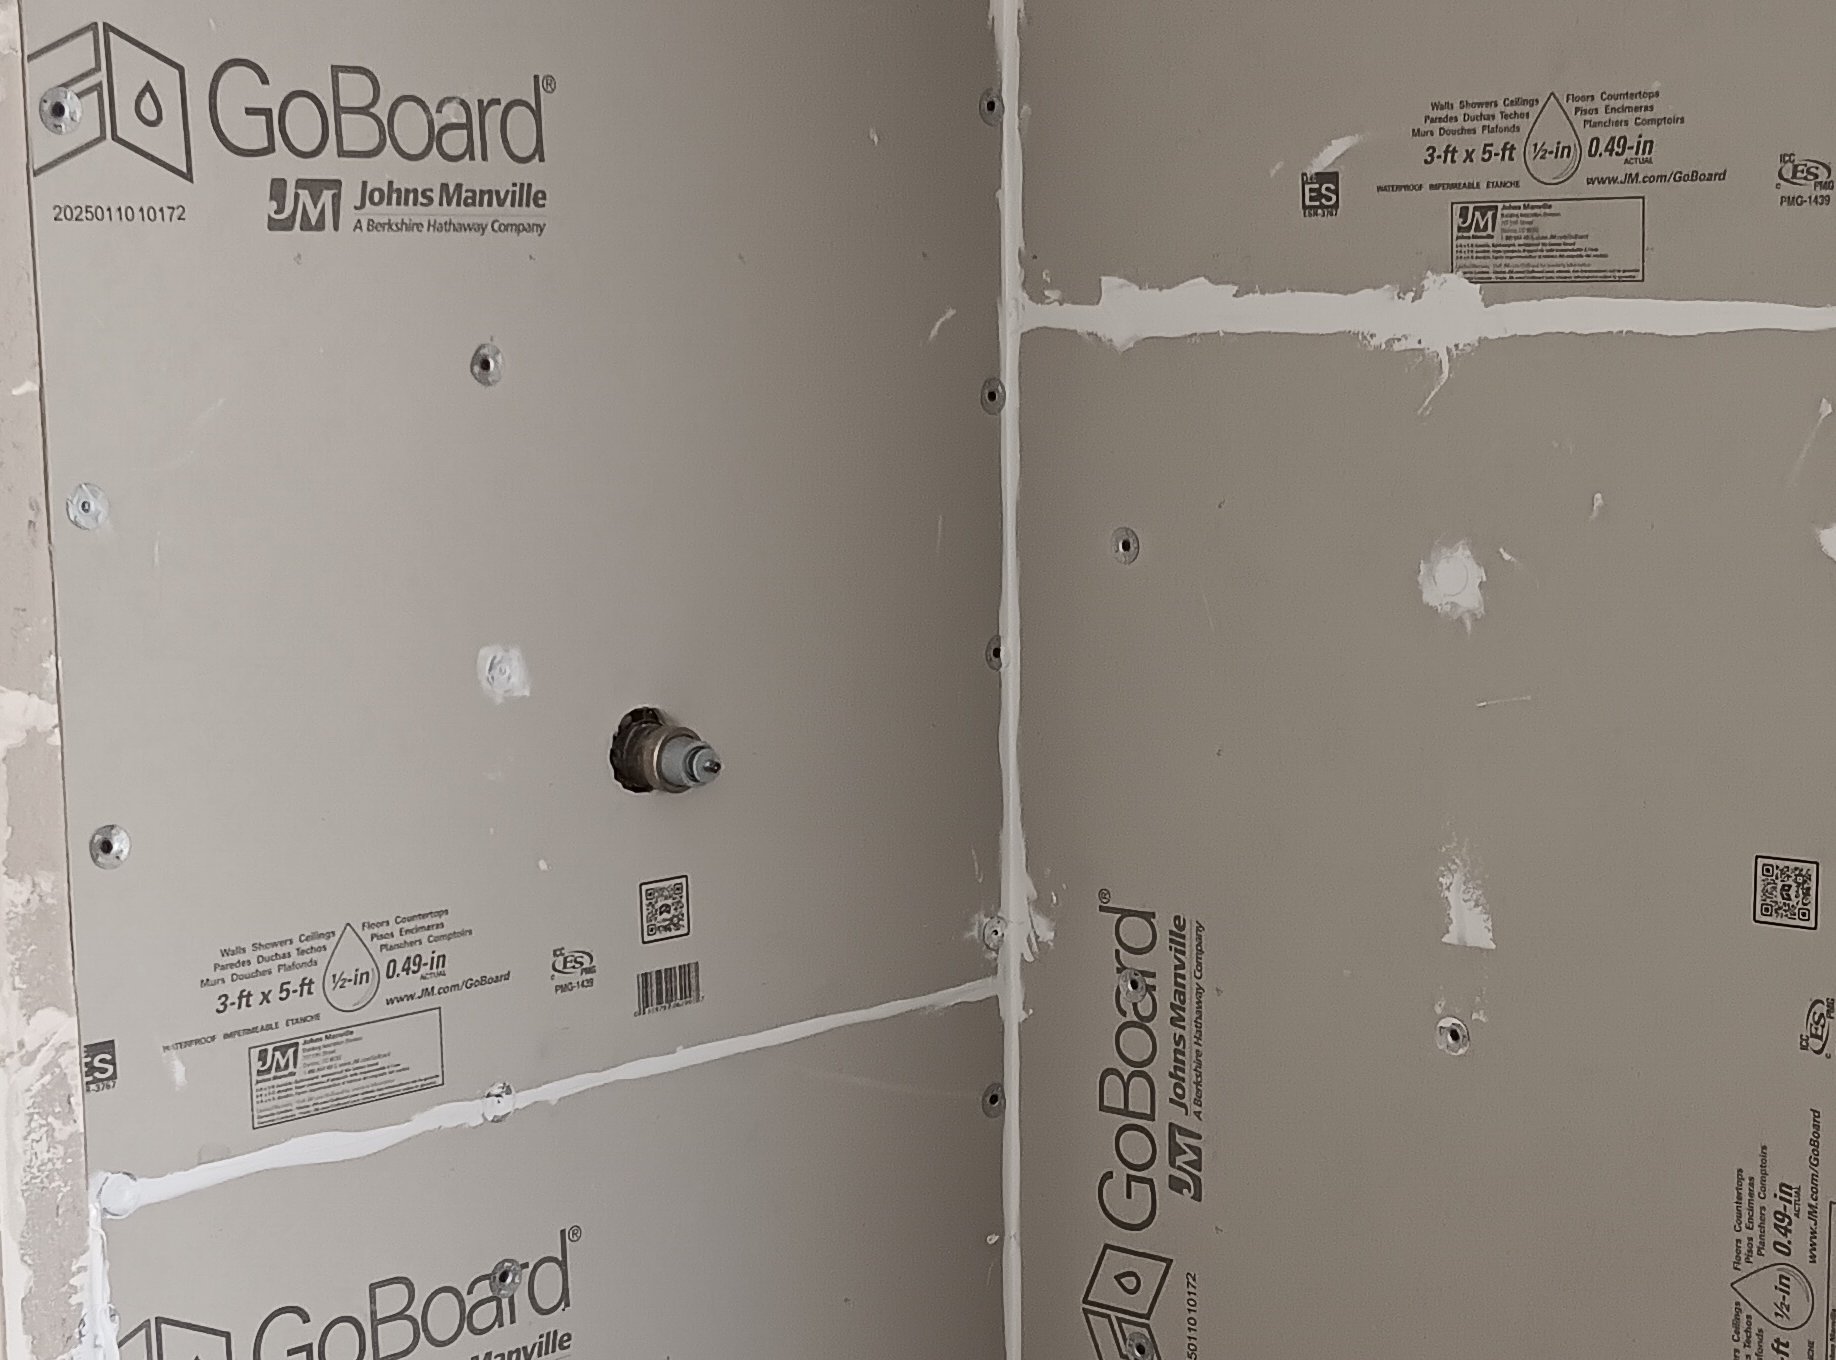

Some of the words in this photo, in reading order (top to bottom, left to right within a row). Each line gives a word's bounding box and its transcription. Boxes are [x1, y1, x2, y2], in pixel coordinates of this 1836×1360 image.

[1566, 93, 1595, 103] Floors
[1600, 90, 1660, 101] Countertops
[1423, 143, 1459, 165] 3-ft
[1462, 147, 1476, 164] x
[1481, 141, 1517, 163] 5-ft
[1587, 134, 1655, 159] 0.49-in
[1586, 168, 1727, 187] www.JM.com/GoBoard
[1791, 164, 1820, 181] ES
[354, 181, 435, 211] Johns
[438, 180, 548, 210] Manville
[1304, 183, 1337, 206] ES
[1780, 194, 1831, 207] PMG-1439
[353, 219, 363, 234] A
[366, 218, 424, 235] Berkshire
[426, 218, 488, 237] Hathaway
[490, 219, 547, 237] Company
[385, 950, 447, 980] 0.49-in
[1194, 921, 1207, 982] Company
[385, 971, 511, 1006] www.JM.com/GoBoard
[1167, 914, 1188, 1030] Manville
[215, 988, 254, 1014] 3-ft
[258, 988, 273, 1006] x
[278, 977, 315, 1002] 5-ft
[1192, 984, 1206, 1046] Hathaway
[256, 1041, 300, 1077] JM
[1167, 1037, 1187, 1116] Johns
[1192, 1049, 1203, 1108] Berkshire
[1192, 1110, 1202, 1120] A
[1758, 1145, 1769, 1200] Comptoirs
[1808, 1109, 1821, 1264] www.JM.com/GoBoard
[1734, 1168, 1745, 1232] Countertops
[1745, 1176, 1755, 1231] Encimeras
[1773, 1182, 1794, 1257] 0.49-in
